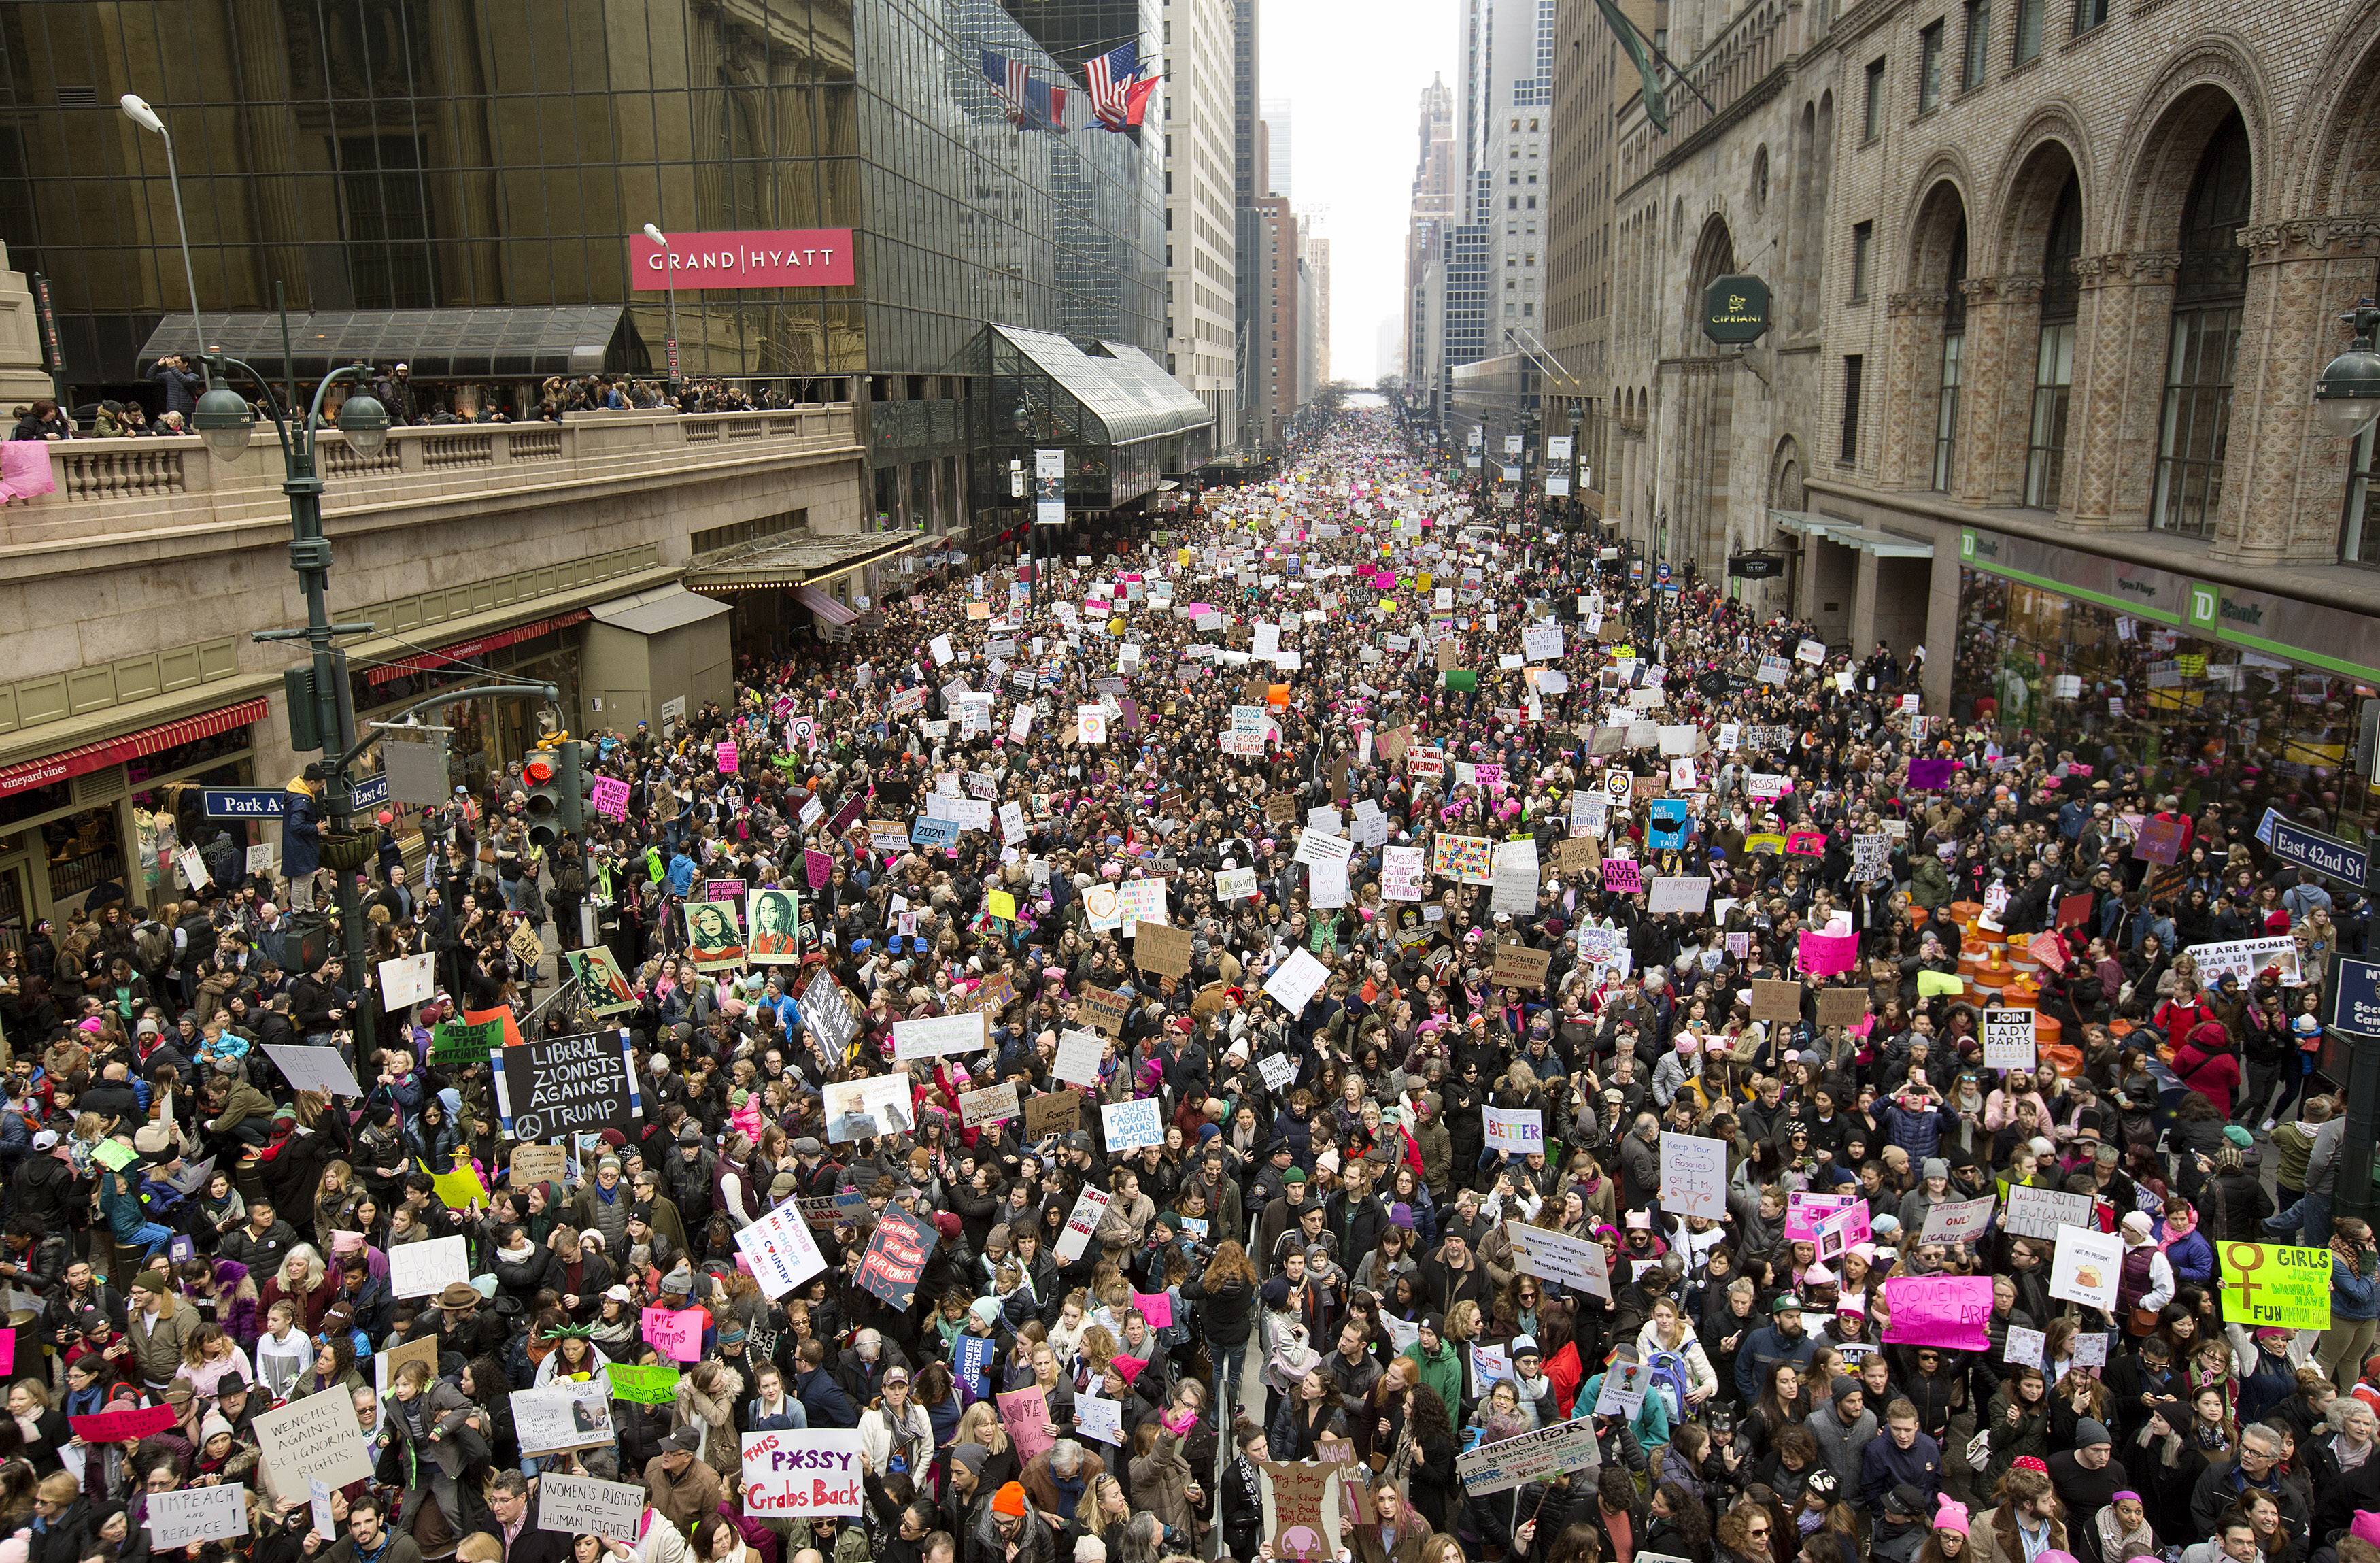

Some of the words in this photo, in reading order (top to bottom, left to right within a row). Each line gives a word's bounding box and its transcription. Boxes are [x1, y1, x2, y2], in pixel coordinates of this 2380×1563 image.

[649, 252, 734, 270] GRAND
[751, 248, 834, 268] HYATT
[1712, 315, 1761, 324] CIPRIANI
[1962, 533, 1974, 556] TD
[2194, 591, 2214, 621] TD
[2221, 597, 2263, 625] Bank
[1236, 708, 1261, 718] BOYS
[1236, 734, 1261, 743] GOOD
[1234, 743, 1264, 754] HUMANS
[1408, 747, 1420, 757] WE
[1421, 748, 1442, 760] SHALL
[2, 771, 42, 789] vineyard
[44, 764, 67, 778] vines
[595, 778, 607, 787] MY
[1750, 777, 1779, 790] RESIST
[356, 789, 375, 805] East
[377, 781, 388, 796] 42
[224, 797, 263, 812] Park
[267, 797, 284, 812] Av
[885, 824, 904, 833] LEGIT
[917, 826, 946, 839] 2020
[920, 818, 956, 833] MICHELLE
[873, 834, 890, 843] MUST
[892, 835, 906, 843] QUIT
[1439, 837, 1459, 846] THIS
[1461, 839, 1467, 847] IS
[1470, 841, 1488, 850] WHAT
[1387, 854, 1423, 865] PUSSIES
[1439, 850, 1486, 862] DEMOCRACY
[2277, 831, 2306, 859] East
[2308, 844, 2342, 871] 42nd
[2345, 858, 2362, 879] St
[1383, 865, 1415, 875] AGAINST
[1441, 861, 1463, 871] LOOKS
[1605, 869, 1637, 879] LIVES
[1606, 861, 1633, 871] ALL
[1393, 876, 1407, 884] THE
[2189, 947, 2211, 957] WE
[2215, 945, 2240, 954] ARE
[2244, 939, 2294, 952] WOMEN
[1498, 952, 1544, 966] PUSSY-GRABBING
[1508, 961, 1540, 971] DICTATOR
[1085, 998, 1123, 1019] TRUMPS
[1083, 1010, 1120, 1028] HATE
[1994, 1012, 2025, 1023] JOIN
[442, 1022, 496, 1037] ABORT
[1988, 1025, 2030, 1035] LADY
[453, 1035, 488, 1047] THE
[1988, 1037, 2030, 1045] PARTS
[279, 1045, 310, 1062] OH
[531, 1037, 607, 1066] LIBERAL
[286, 1060, 320, 1073] HELL
[1263, 1056, 1278, 1068] THE
[1263, 1061, 1289, 1078] FUTURE
[532, 1056, 622, 1088] ZIONISTS
[1268, 1069, 1292, 1088] FEMALE
[530, 1075, 626, 1108] AGAINST
[537, 1098, 619, 1128] TRUMP
[1114, 1100, 1151, 1115] JEWISH
[1110, 1109, 1155, 1127] FAGGOTS
[1118, 1120, 1156, 1136] AGAINST
[1488, 1119, 1541, 1140] BETTER
[1108, 1131, 1165, 1150] NEO-FACISM
[1667, 1139, 1688, 1154] Keep
[1693, 1143, 1710, 1155] Your
[1674, 1158, 1707, 1171] Rosaries
[1669, 1175, 1683, 1185] Off
[1701, 1180, 1714, 1192] My
[881, 1221, 896, 1232] OUR
[896, 1225, 918, 1240] BODIES
[885, 1239, 901, 1253] OUR
[899, 1248, 921, 1263] MINDS
[1525, 1235, 1559, 1249] Women's
[1562, 1245, 1586, 1258] Rights
[1558, 1255, 1573, 1264] NOT
[2277, 1248, 2329, 1268] GIRLS
[396, 1264, 466, 1284] TRUMP
[866, 1254, 887, 1269] OUR
[886, 1262, 913, 1280] POWER
[1533, 1259, 1582, 1279] Negotiable
[2288, 1269, 2326, 1283] JUST
[1890, 1281, 1978, 1303] WOMEN'S
[2271, 1283, 2315, 1296] WANNA
[2294, 1296, 2325, 1307] HAVE
[1890, 1303, 1952, 1323] RIGHTS
[1960, 1305, 1990, 1324] ARE
[2253, 1305, 2311, 1323] FUNDAMENTAL
[2312, 1307, 2330, 1326] RIGHTS
[609, 1367, 649, 1385] NOT
[615, 1382, 673, 1402] PRESIDEN
[1604, 1394, 1639, 1406] TOGETHER
[1605, 1387, 1642, 1400] STRONGER
[1078, 1396, 1112, 1416] Science
[270, 1402, 340, 1436] WENCHES
[1083, 1419, 1100, 1432] Real
[277, 1417, 340, 1450] AGAINST
[269, 1428, 362, 1470] SEIGNORIAL
[742, 1435, 779, 1463] THIS
[158, 1488, 235, 1513] IMPEACH
[544, 1481, 597, 1502] WOMEN'S
[602, 1487, 641, 1508] RIGHTS
[747, 1480, 809, 1511] Grabs
[813, 1479, 860, 1507] Back
[184, 1511, 205, 1520] AND
[575, 1503, 604, 1515] ARE
[543, 1513, 583, 1528] HUMAN
[161, 1521, 222, 1543] REPLACE
